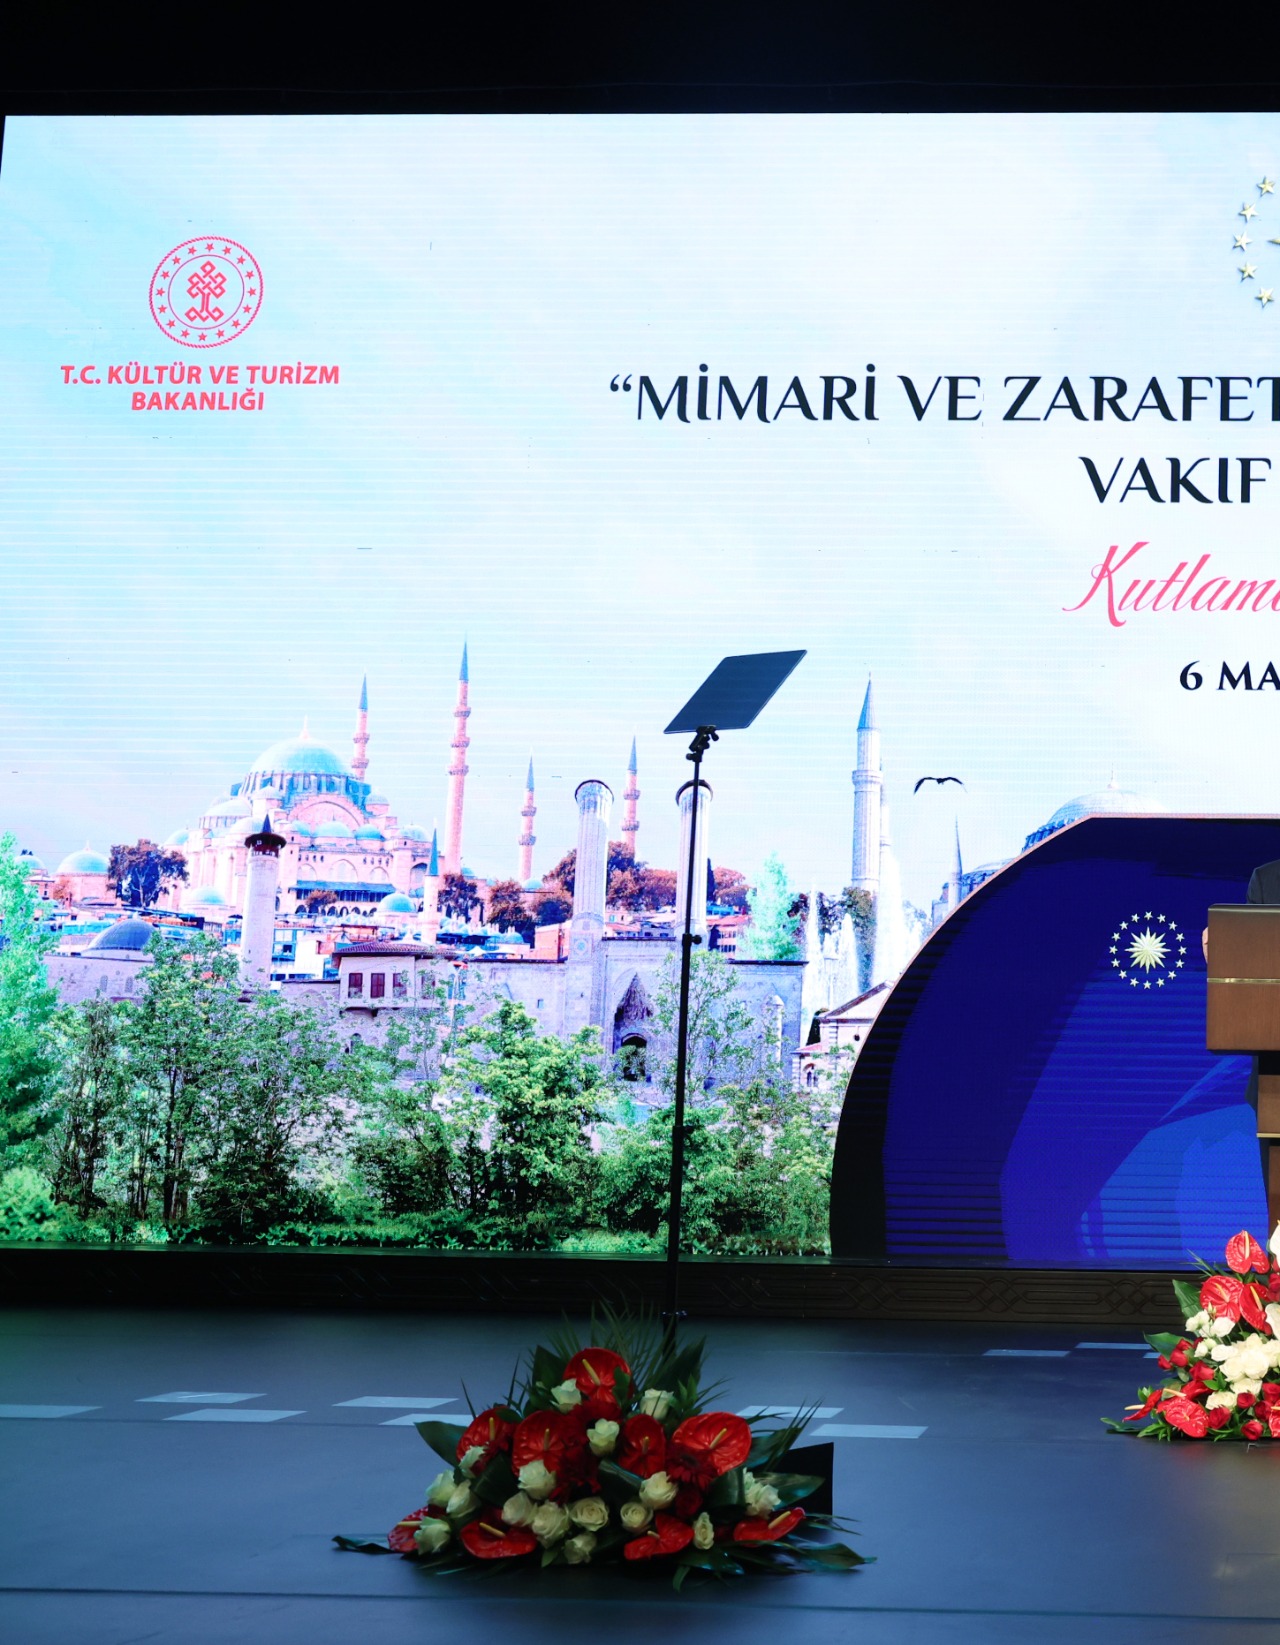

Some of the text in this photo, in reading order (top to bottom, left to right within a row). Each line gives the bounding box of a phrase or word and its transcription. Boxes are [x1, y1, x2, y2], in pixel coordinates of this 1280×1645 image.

[60, 360, 340, 386] T.C. KÜLTÜR VE TURİZM
[131, 387, 265, 411] BAKANLIĞI
[609, 363, 881, 424] “MİMARİ
[896, 375, 982, 422] VE
[1078, 457, 1272, 504] VAKIF
[1179, 660, 1203, 691] 6
